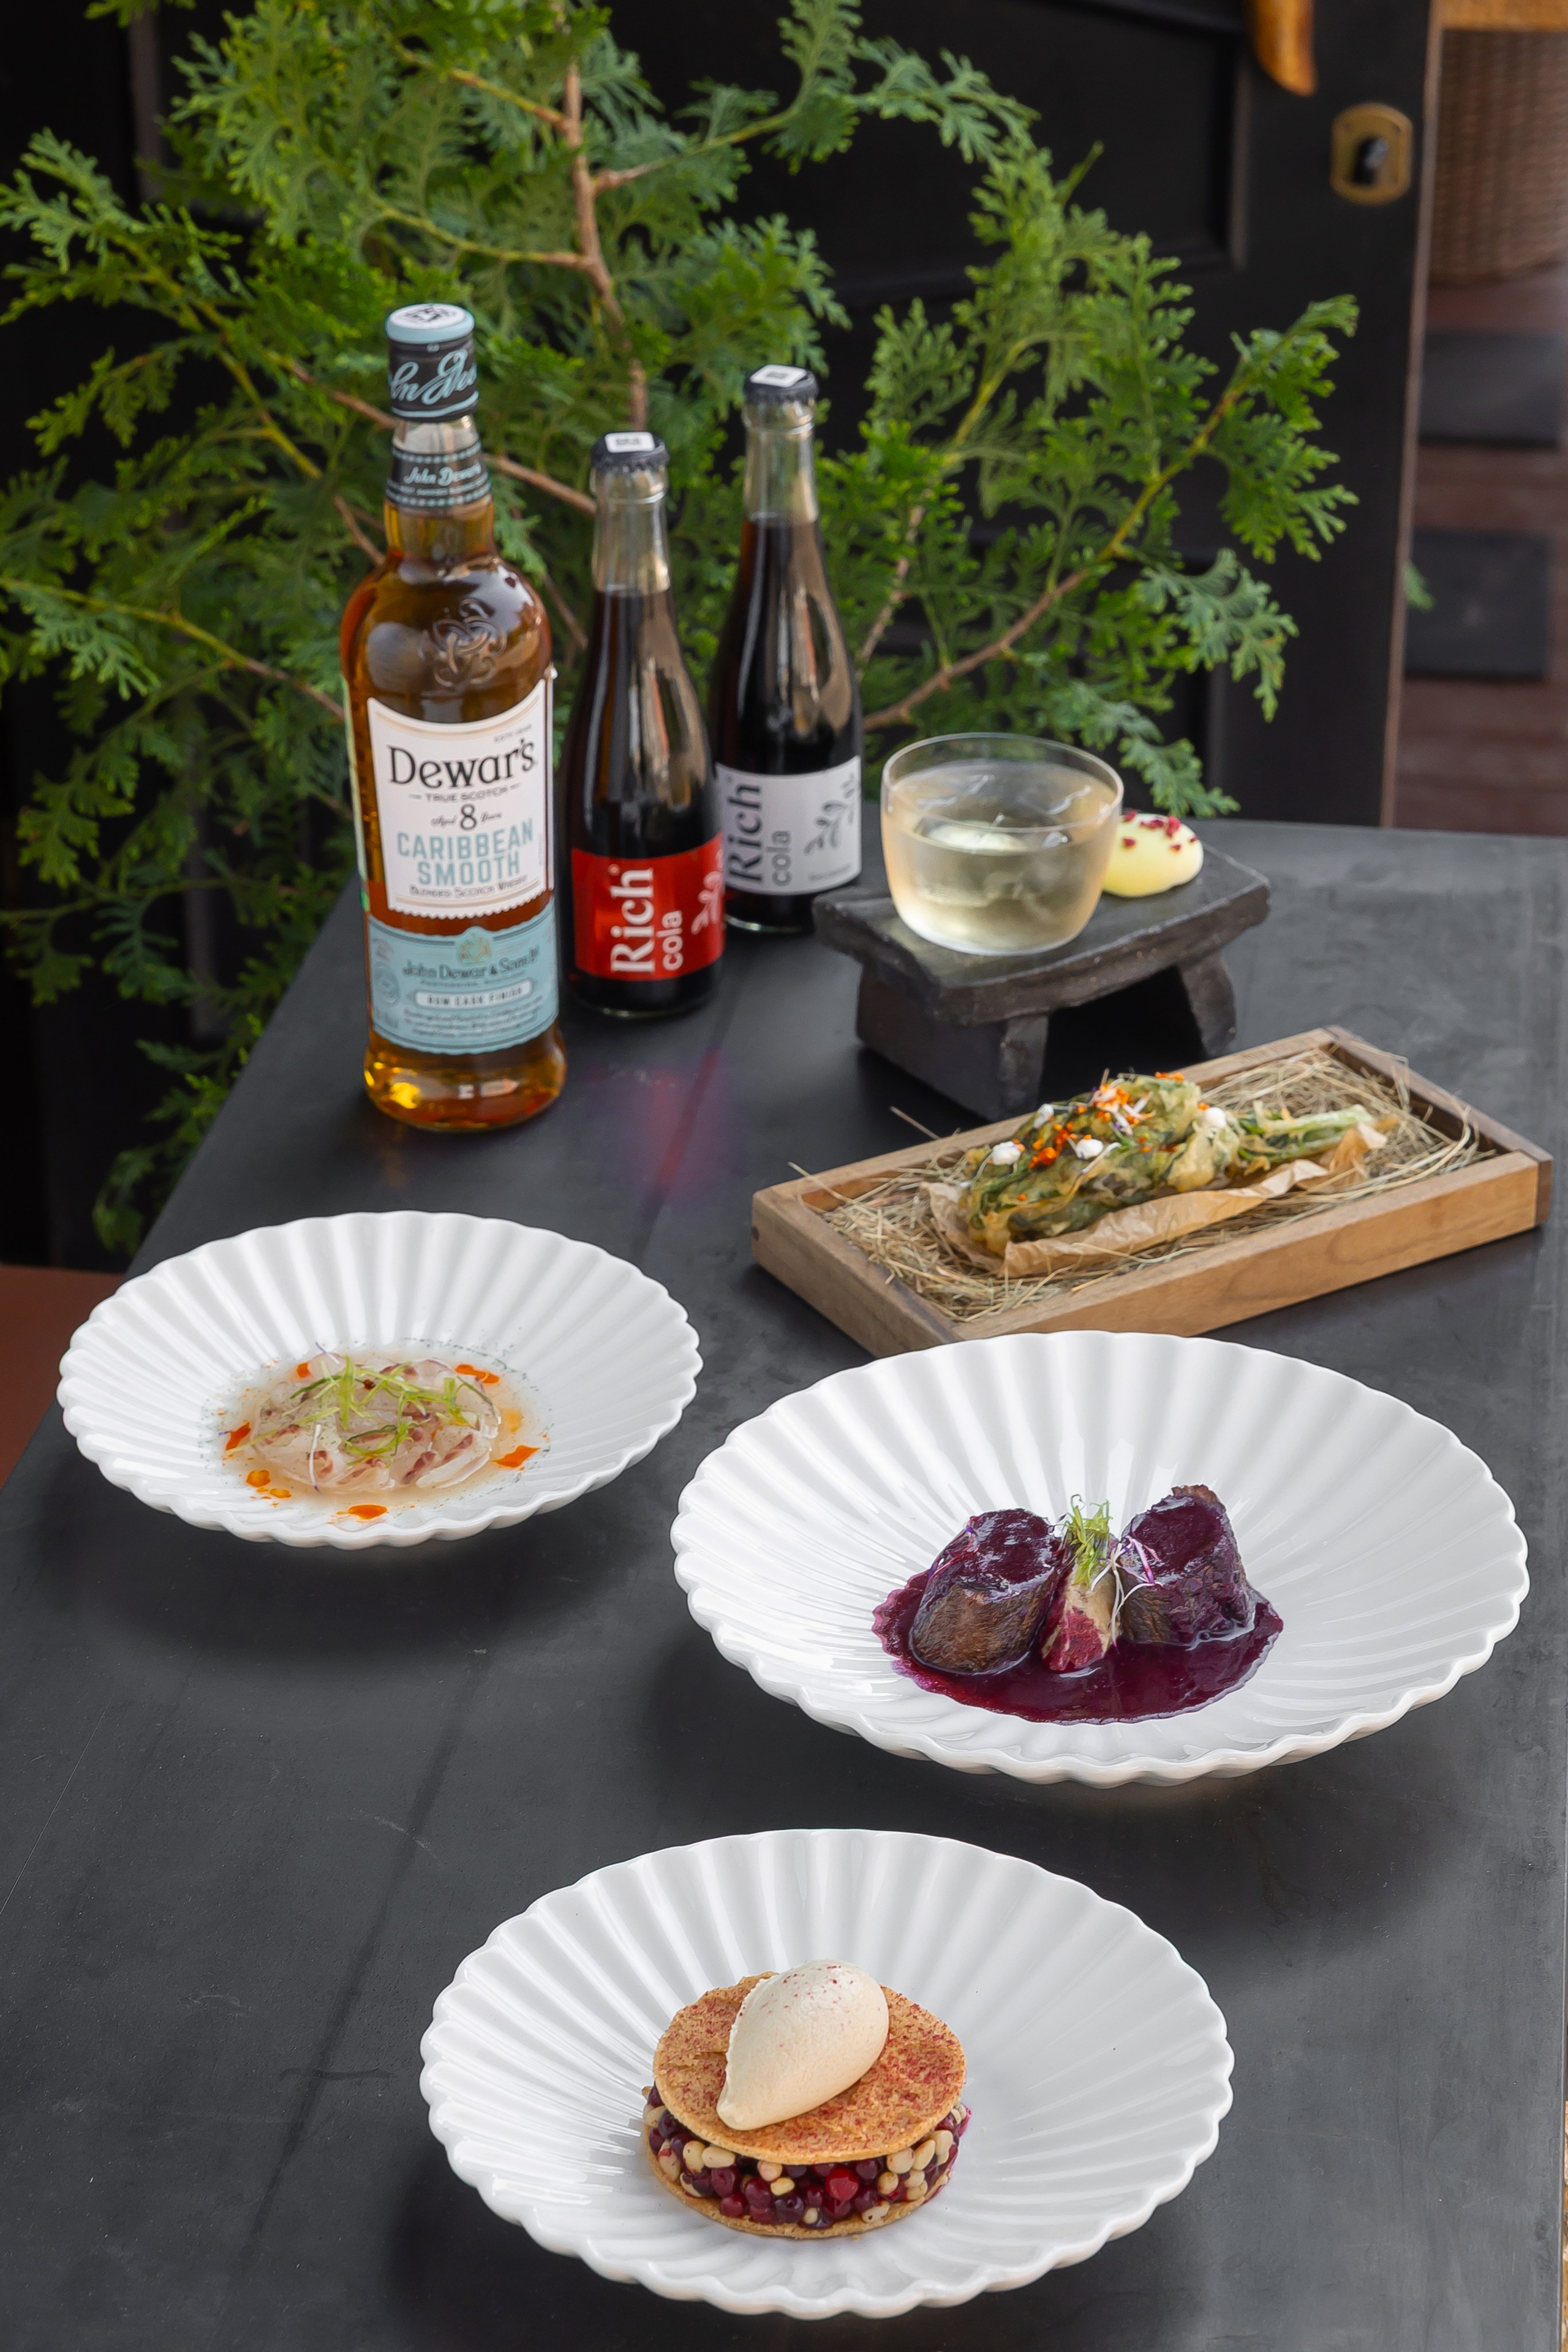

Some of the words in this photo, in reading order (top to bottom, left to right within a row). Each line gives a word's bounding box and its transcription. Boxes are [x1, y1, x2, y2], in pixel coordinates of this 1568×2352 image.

[388, 739, 536, 788] Dewar's
[397, 818, 533, 860] CARIBBEAN
[460, 804, 477, 831] 8
[727, 783, 763, 883] Rich
[418, 851, 519, 886] SMOOTH
[766, 831, 791, 886] cola
[610, 868, 656, 974] Rich
[655, 910, 684, 971] cola
